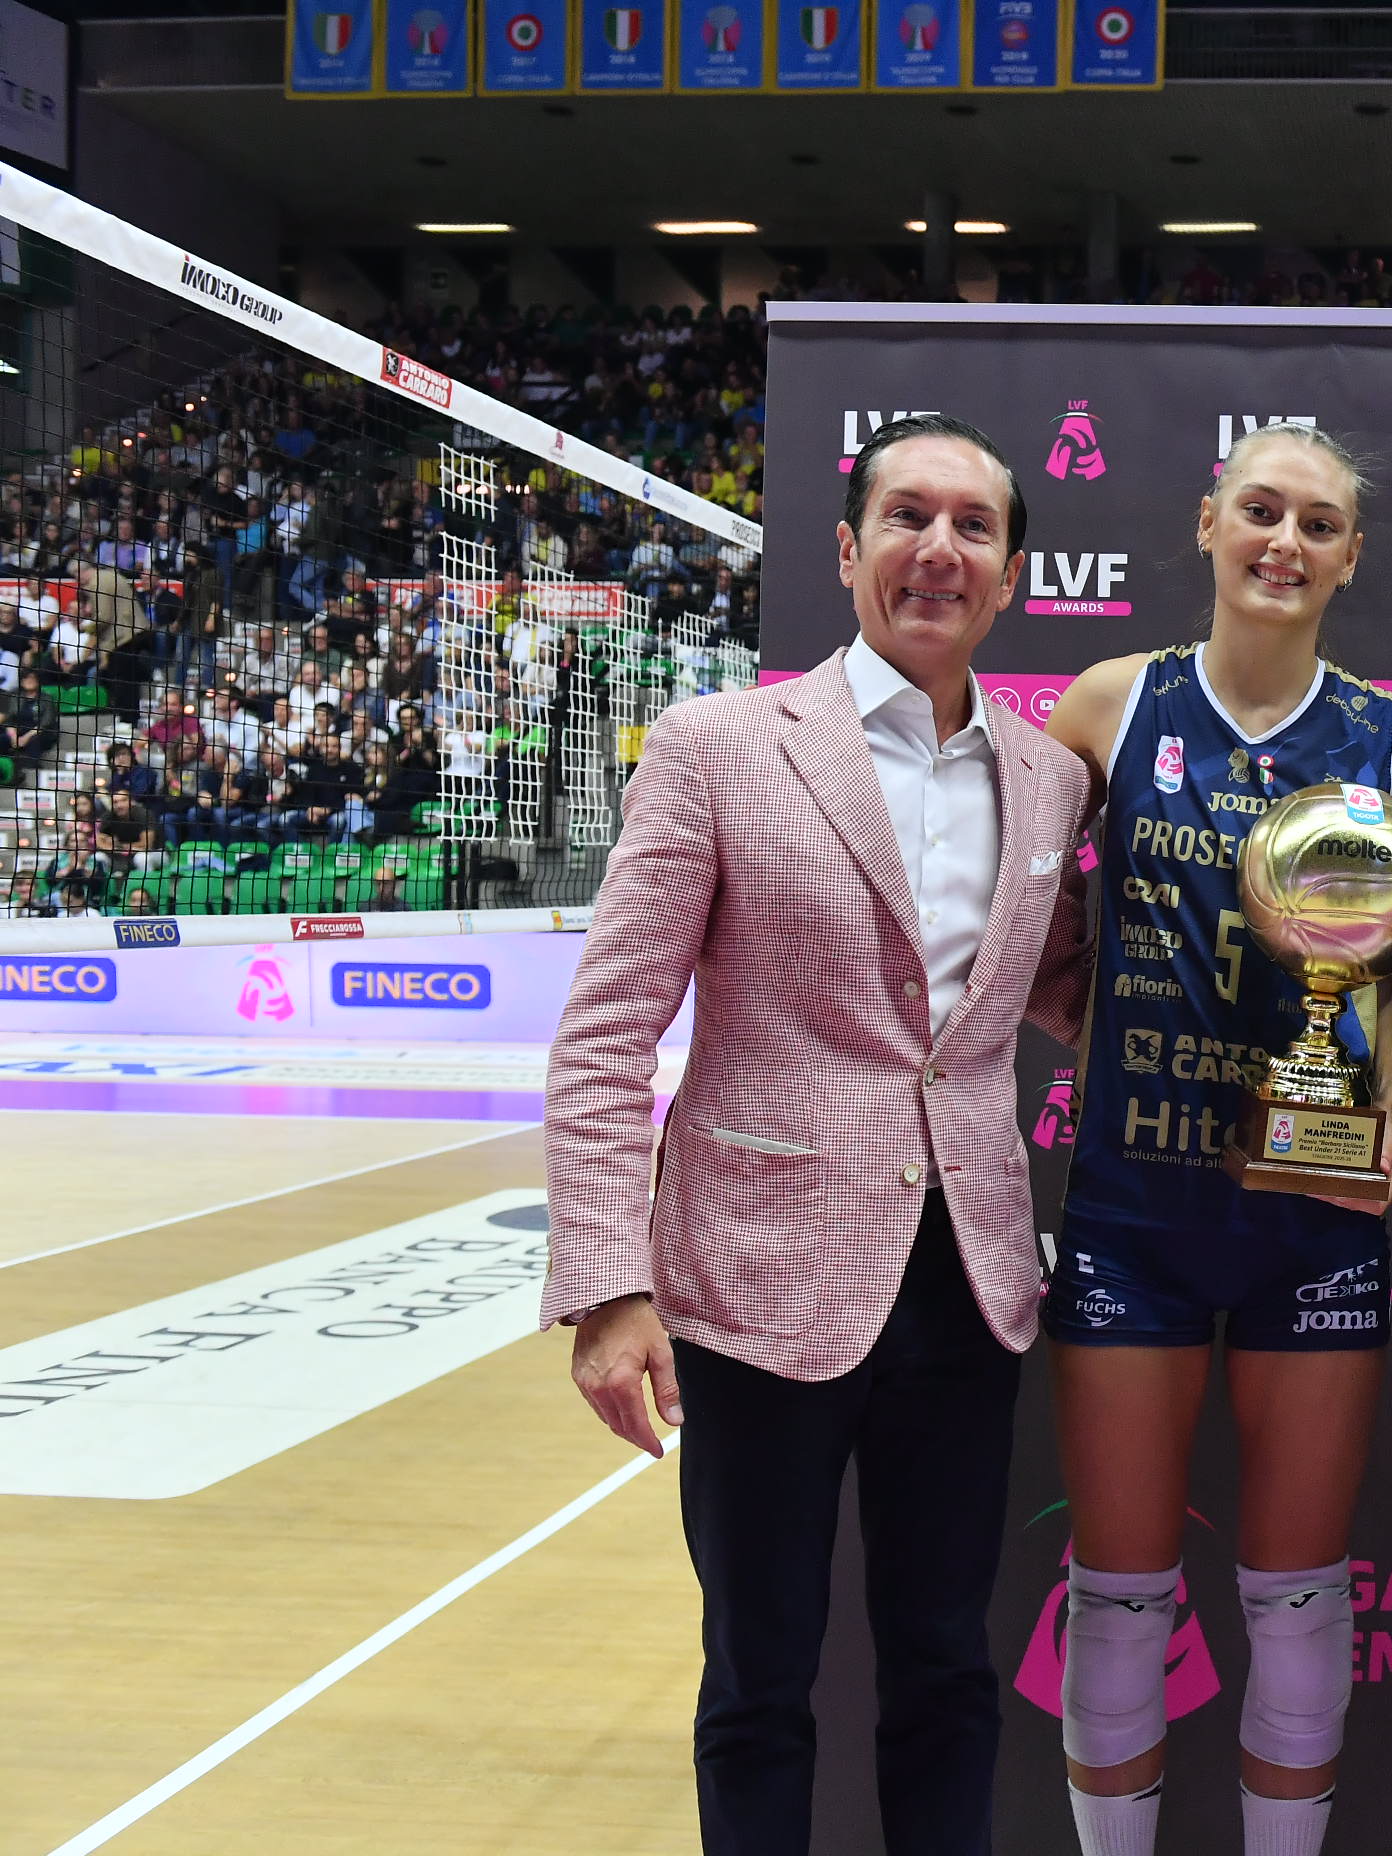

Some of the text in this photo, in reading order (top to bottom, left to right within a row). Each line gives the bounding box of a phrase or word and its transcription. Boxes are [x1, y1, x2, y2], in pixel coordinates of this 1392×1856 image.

[240, 294, 283, 324] GROUP
[398, 371, 448, 405] CARRARO
[402, 360, 449, 389] ANTONIO
[1068, 400, 1088, 410] LVF
[1030, 552, 1128, 598] LVF
[1053, 603, 1105, 613] AWARDS
[1132, 817, 1246, 870] PROSE
[119, 924, 176, 942] FINECO
[310, 922, 363, 934] FRECCIAROSSA
[1214, 909, 1246, 1005] 5
[0, 966, 107, 994] INECO
[343, 971, 481, 1001] FINECO
[1174, 1034, 1271, 1063] ANTO
[1304, 1128, 1365, 1141] MANFREDINI
[1321, 1120, 1350, 1130] LINDA
[1122, 1150, 1181, 1165] soluzioni
[1185, 1156, 1202, 1167] ad
[1314, 1146, 1332, 1154] Under
[1342, 1148, 1359, 1156] Serie
[193, 1237, 522, 1319] BANCA
[1076, 1300, 1126, 1316] FUCHS
